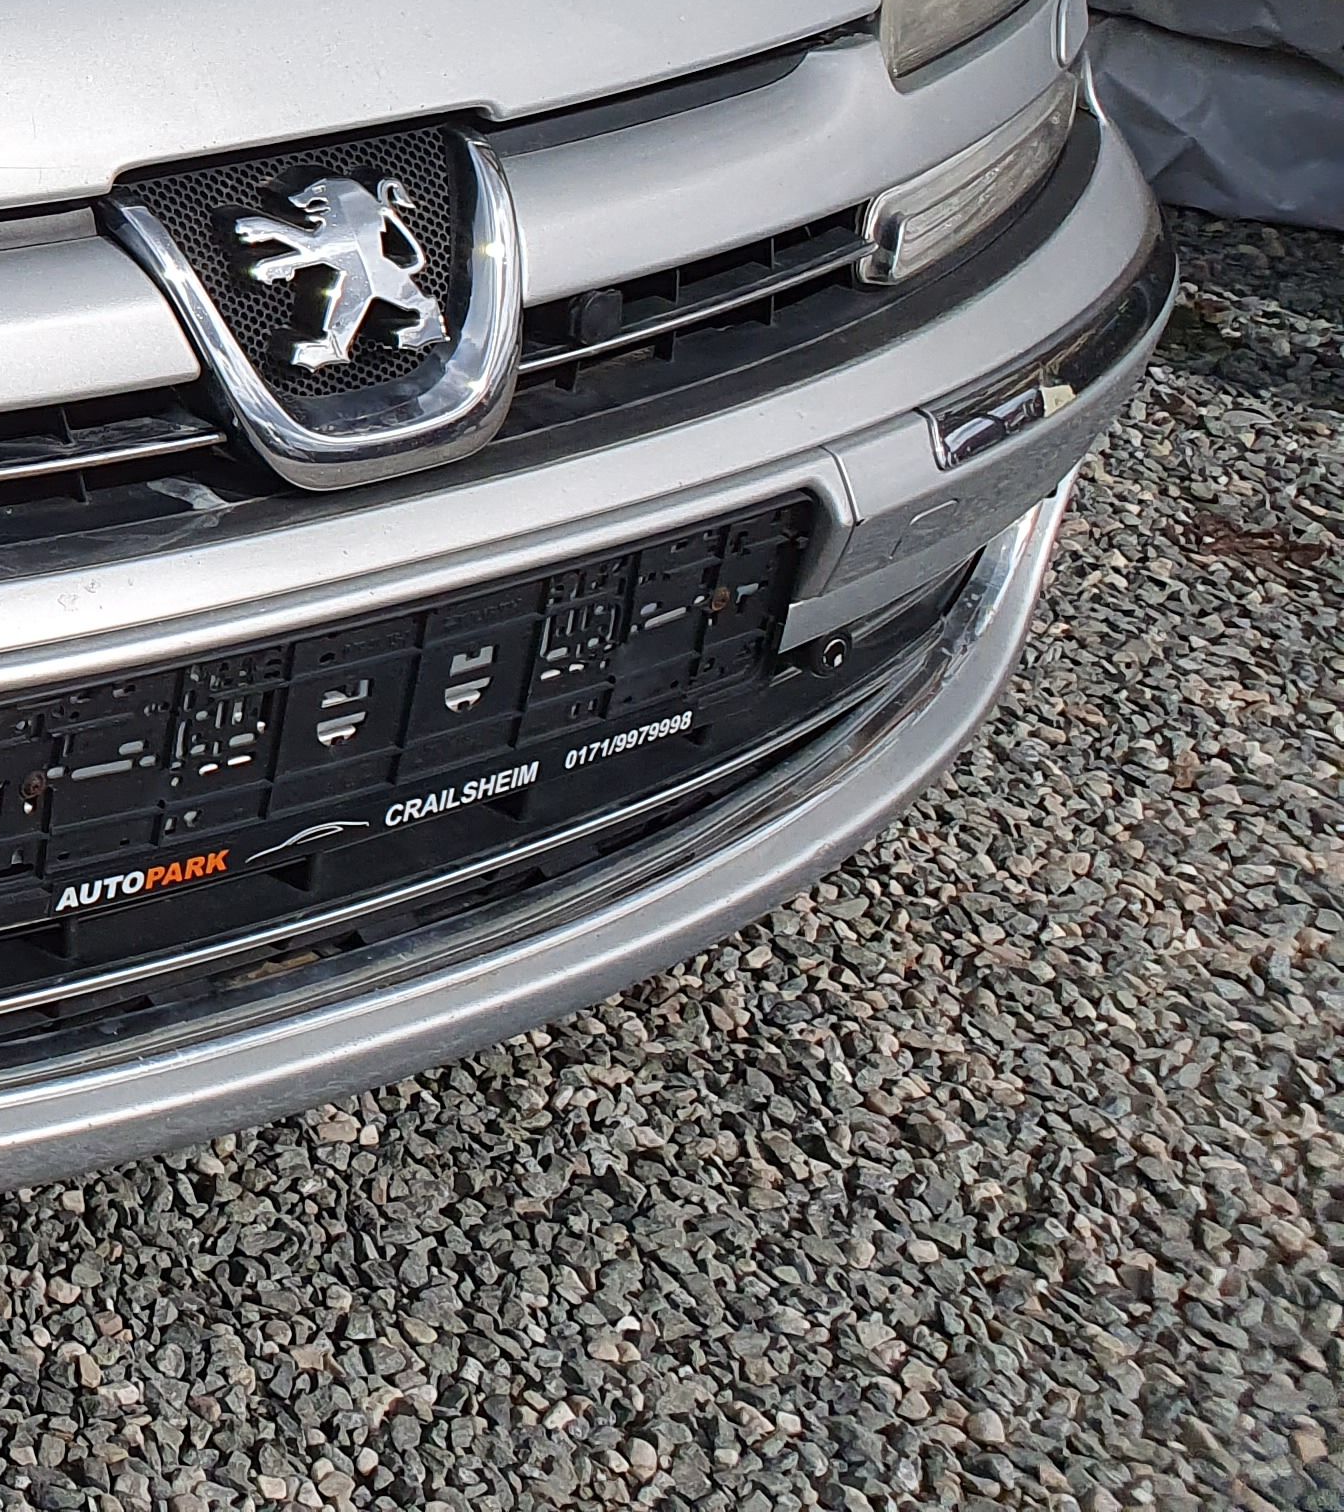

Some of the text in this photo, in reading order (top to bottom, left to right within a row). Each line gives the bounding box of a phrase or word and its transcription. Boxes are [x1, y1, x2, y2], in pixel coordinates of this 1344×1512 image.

[55, 710, 693, 912] AUTOPARK CRAILSHEIM 0171/9979998
